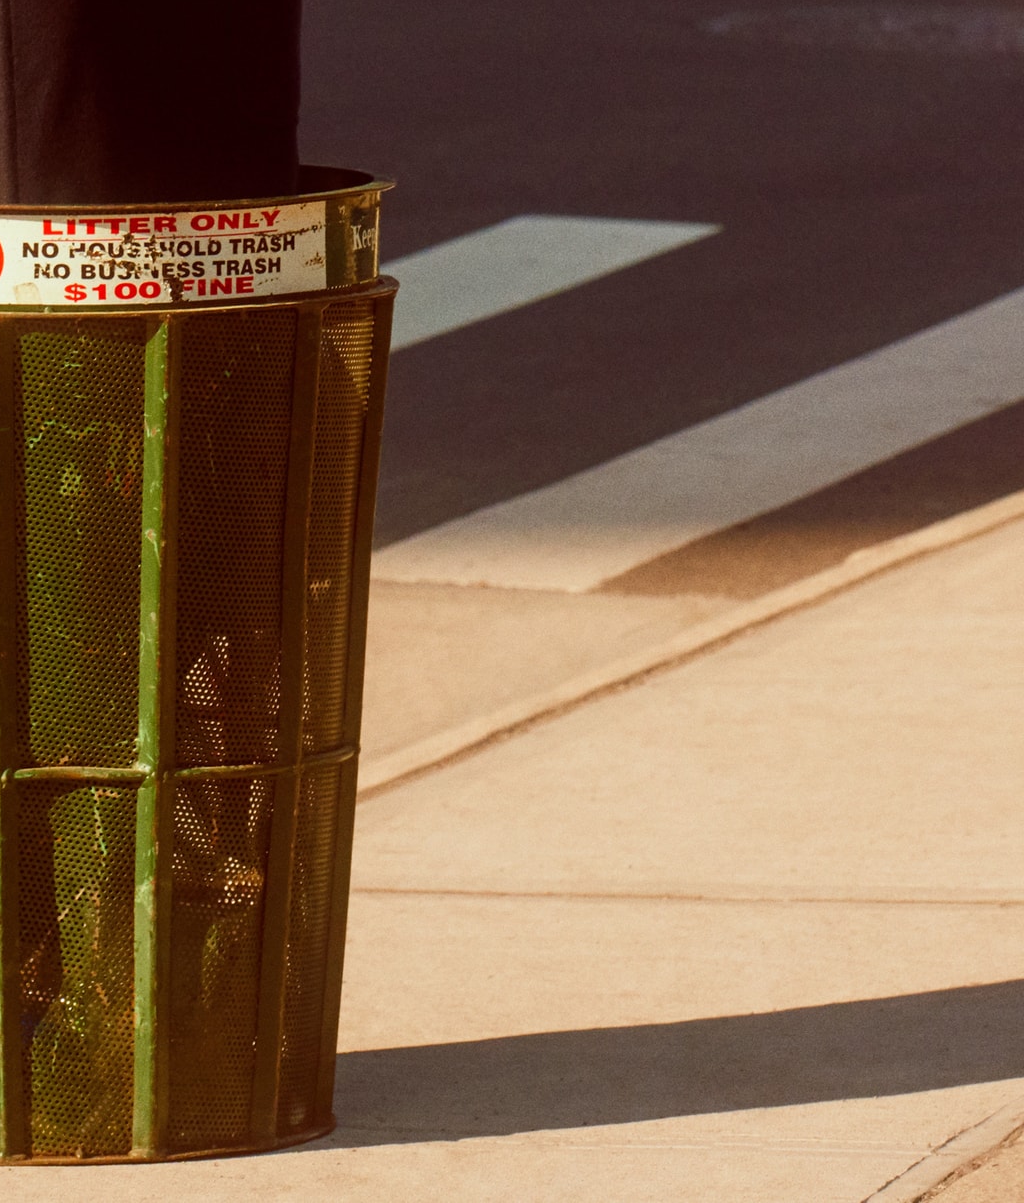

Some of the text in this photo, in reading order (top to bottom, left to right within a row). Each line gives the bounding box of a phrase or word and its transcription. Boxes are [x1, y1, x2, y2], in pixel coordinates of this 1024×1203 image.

[43, 209, 281, 235] LITTER ONLY
[22, 242, 59, 258] NO
[229, 235, 295, 255] TRASH
[34, 262, 71, 279] NO
[212, 257, 281, 276] TRASH
[64, 276, 254, 302] $100 FINE
